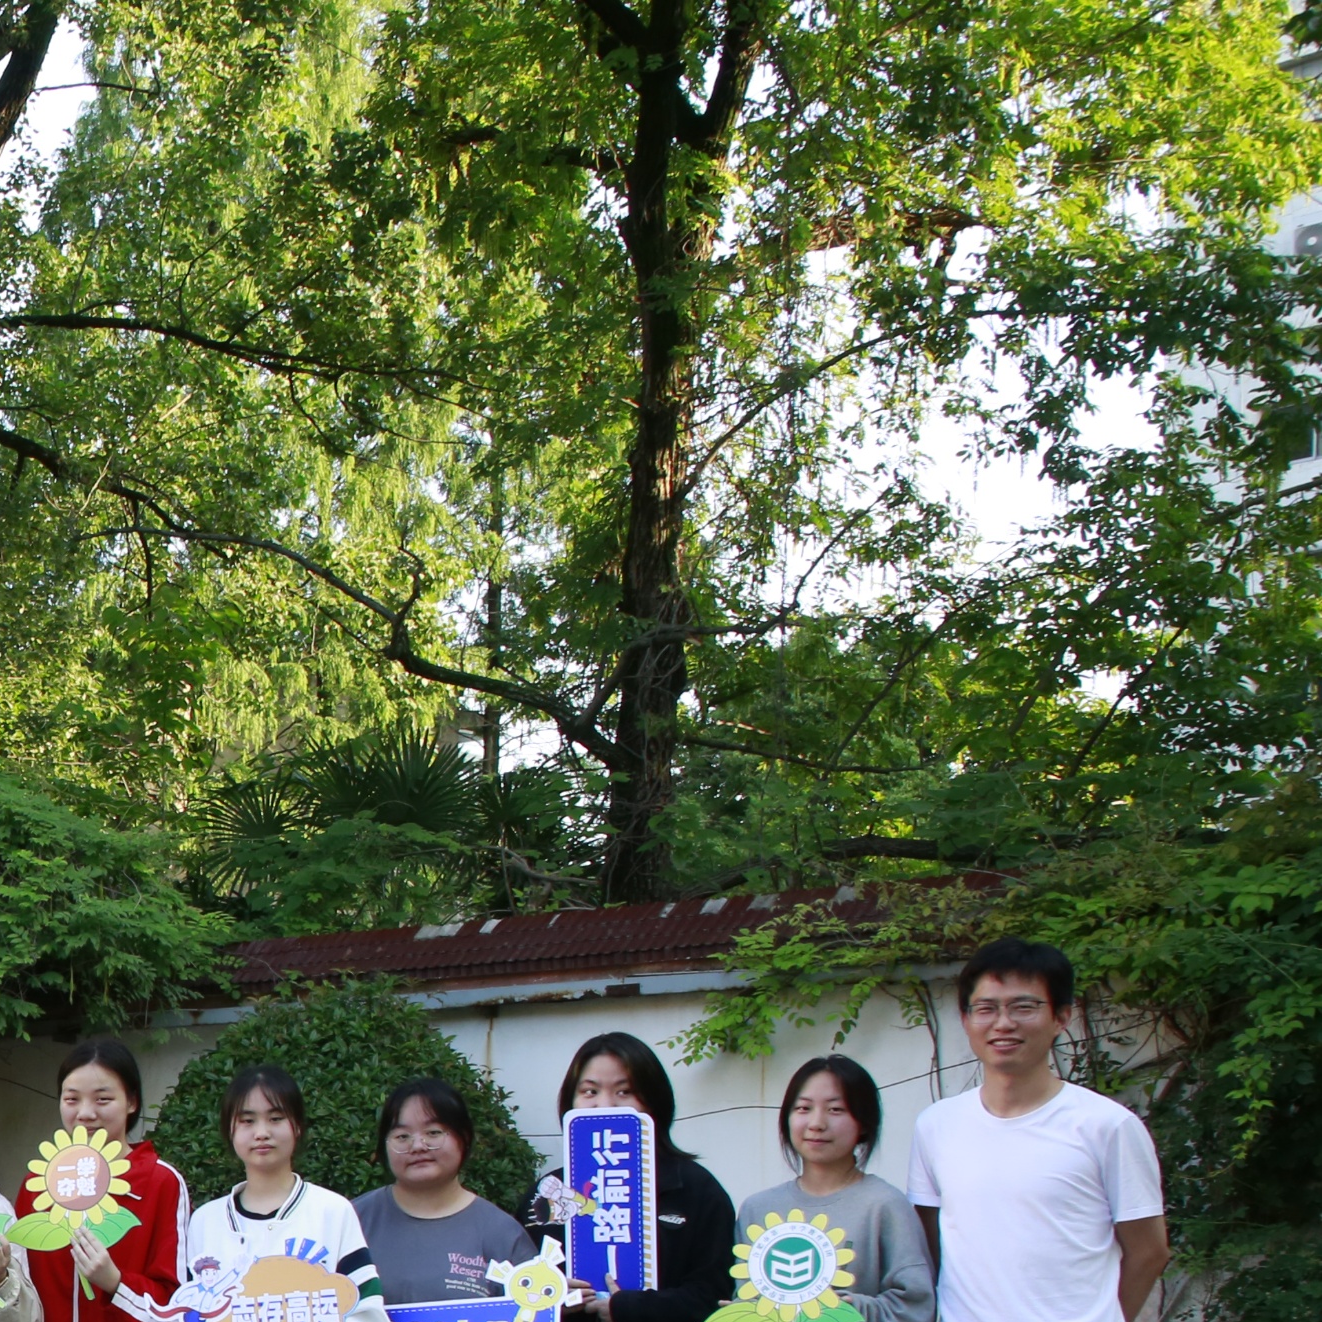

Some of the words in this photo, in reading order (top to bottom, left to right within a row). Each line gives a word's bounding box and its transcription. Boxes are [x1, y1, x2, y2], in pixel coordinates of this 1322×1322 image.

[57, 1156, 97, 1177] 一举
[57, 1177, 97, 1197] 夺魁
[591, 1129, 632, 1280] 一路前行
